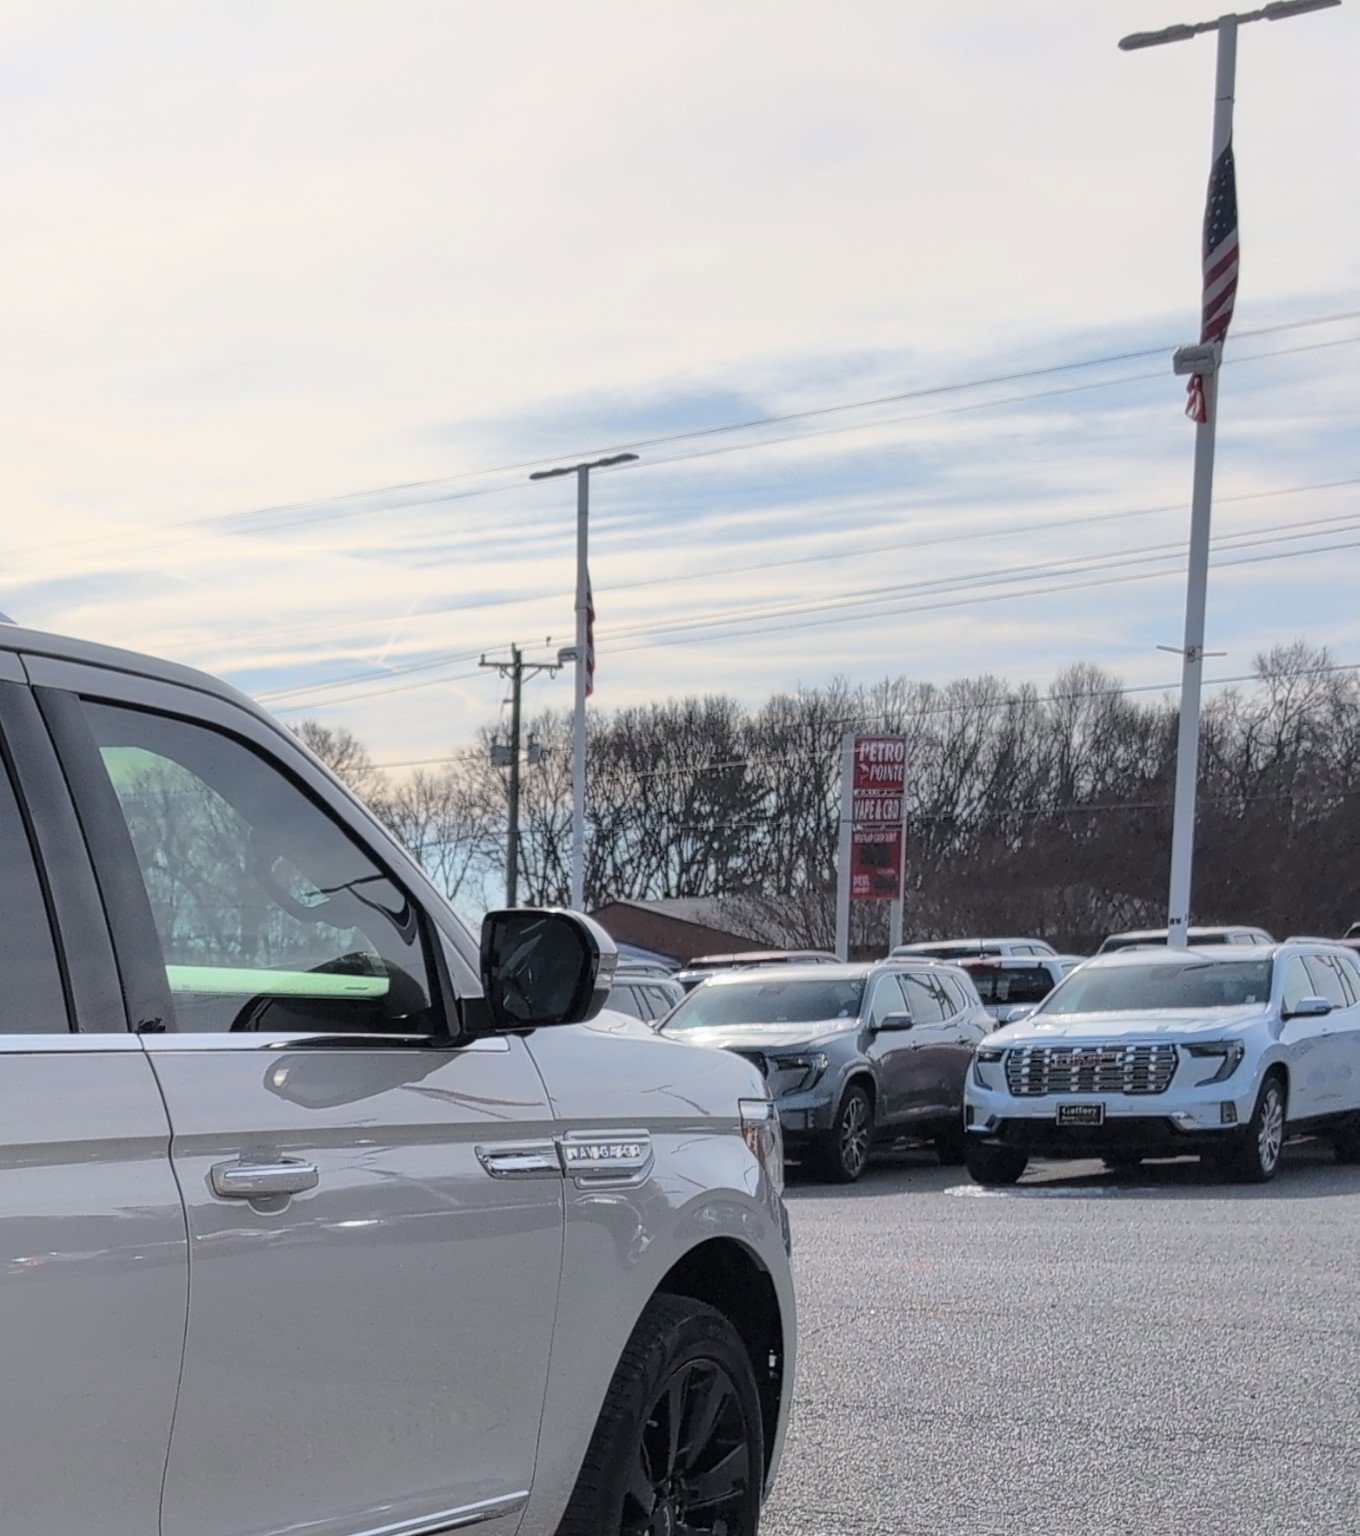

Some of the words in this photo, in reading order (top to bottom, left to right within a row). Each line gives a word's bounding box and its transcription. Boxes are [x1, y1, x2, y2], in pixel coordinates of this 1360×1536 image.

[859, 741, 904, 763] PETRO
[869, 764, 904, 782] POINTE
[854, 799, 875, 820] VAPE
[883, 799, 900, 820] CBD
